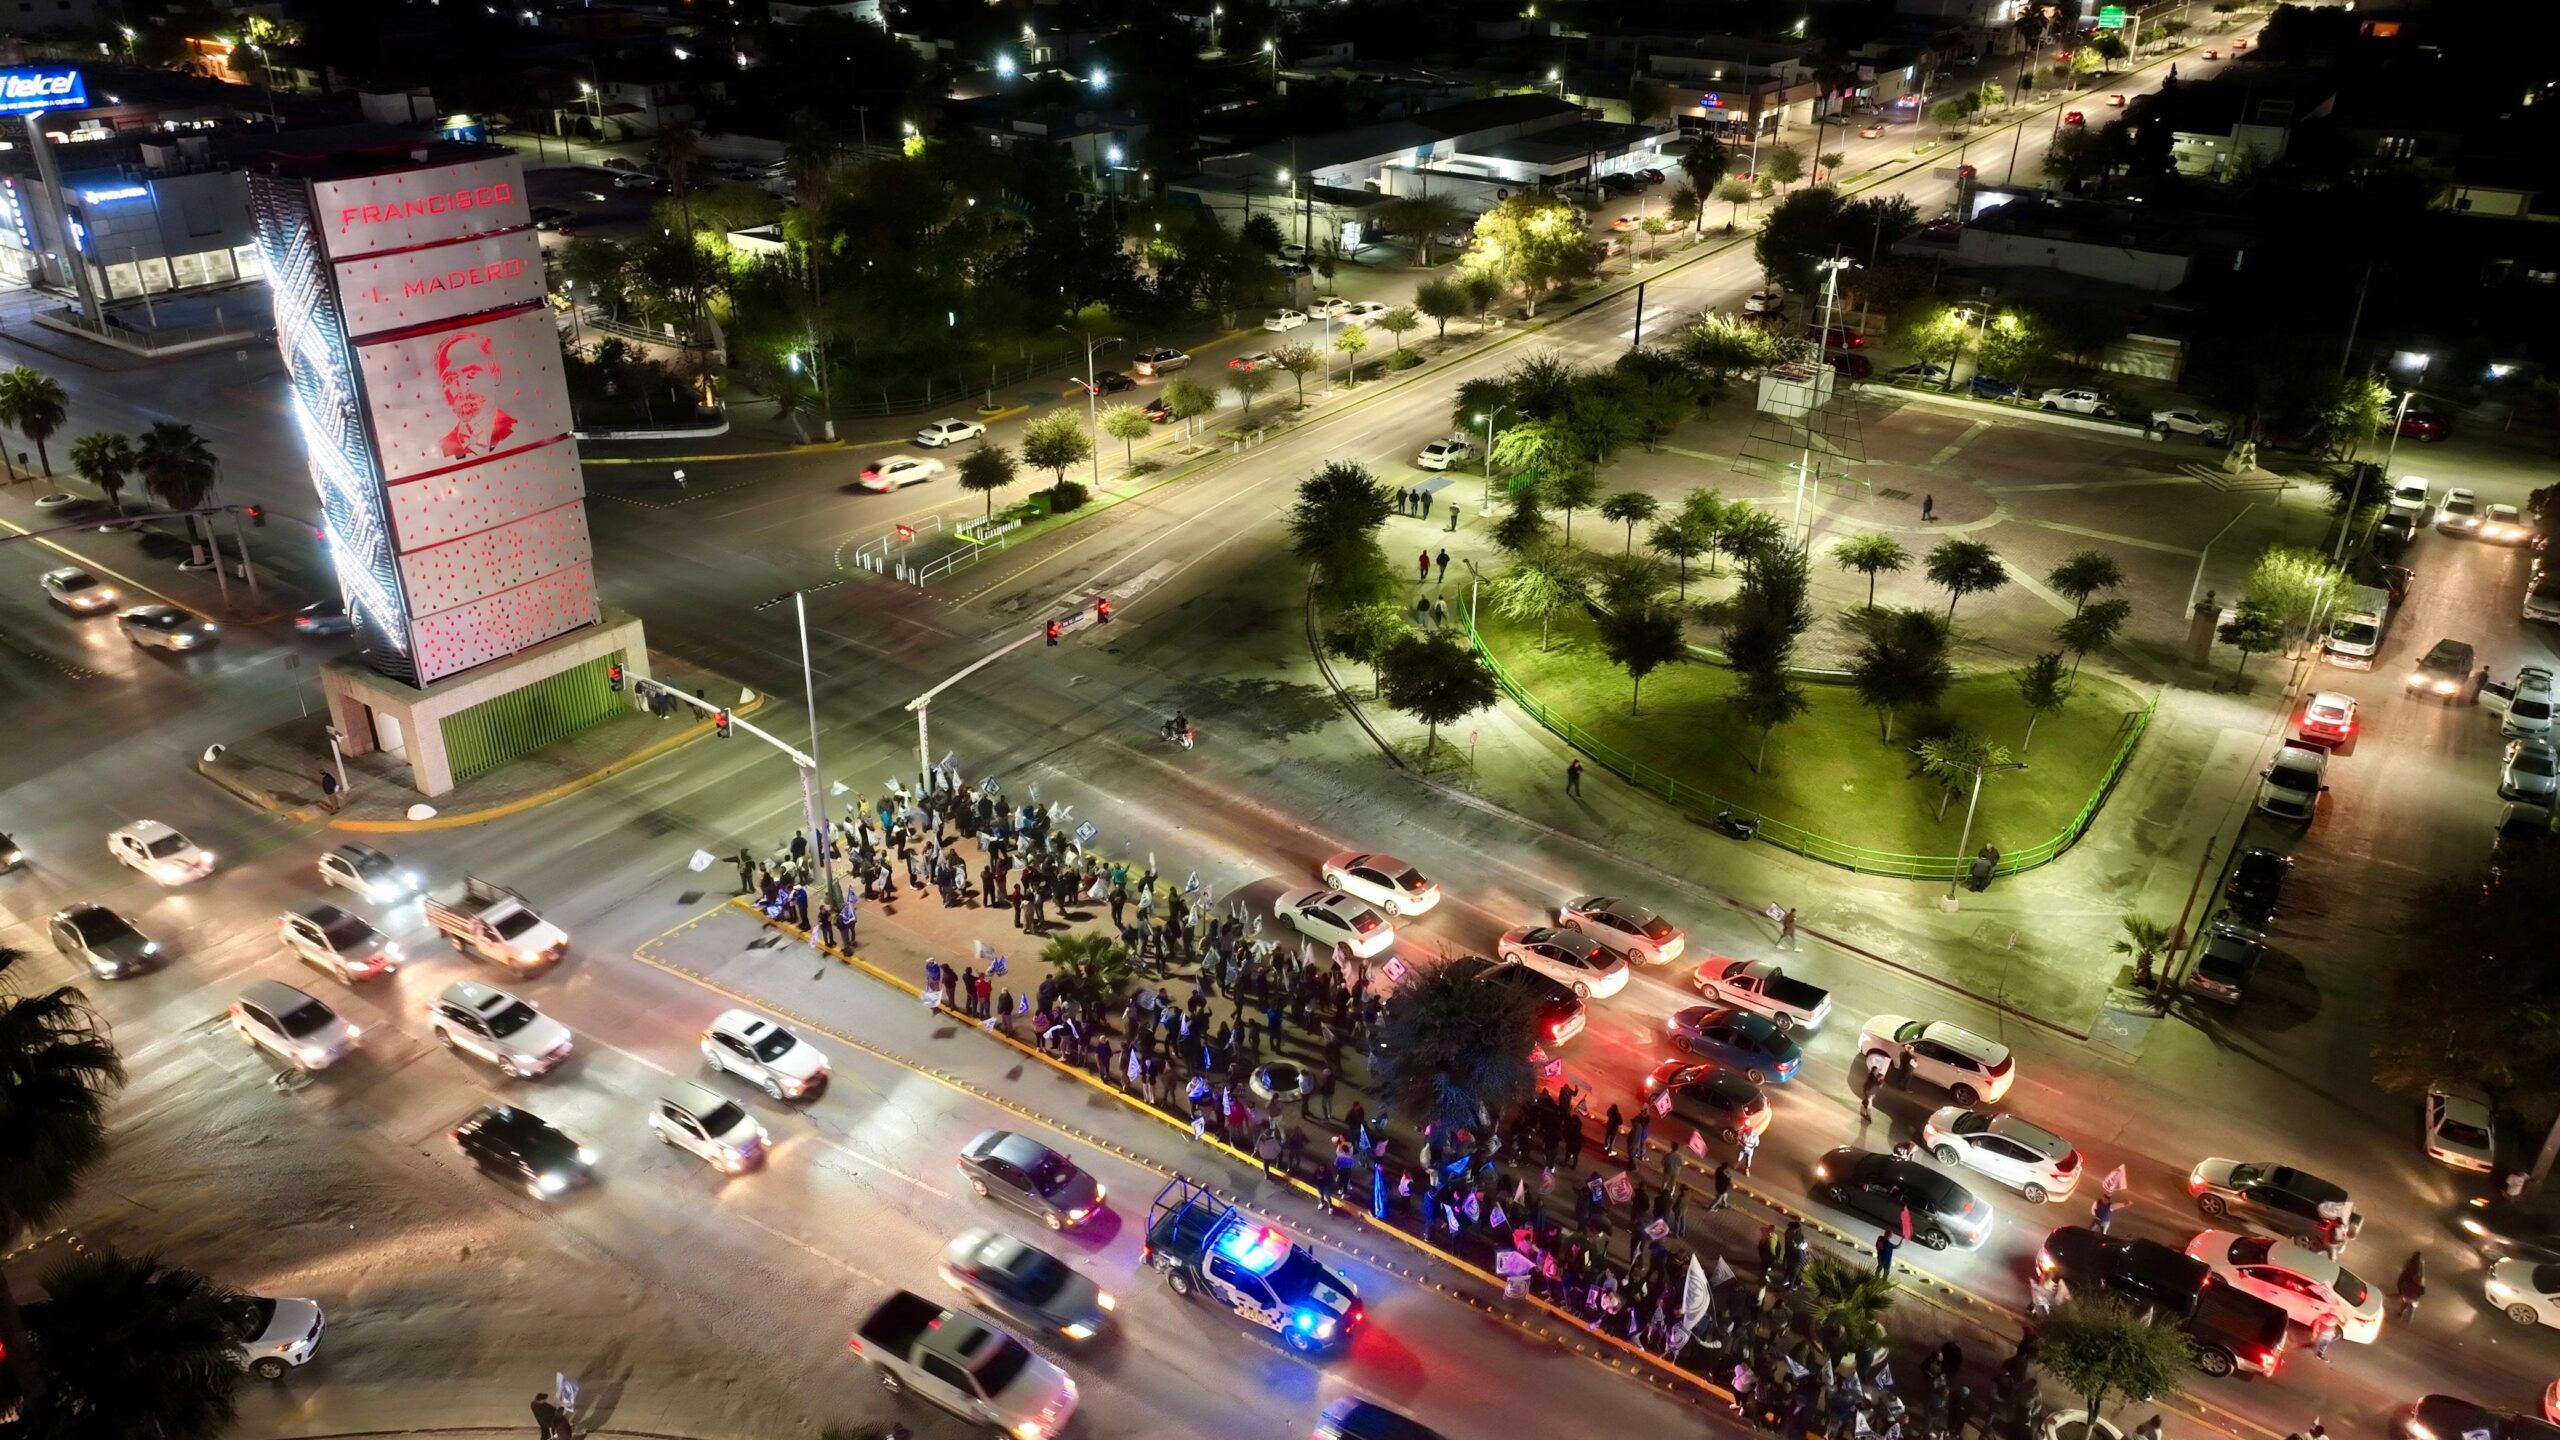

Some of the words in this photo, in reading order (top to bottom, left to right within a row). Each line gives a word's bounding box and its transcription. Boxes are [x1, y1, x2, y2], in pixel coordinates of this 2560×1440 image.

[6, 71, 77, 97] telcel
[341, 184, 512, 227] FRANCISCO
[403, 258, 521, 298] MADERO
